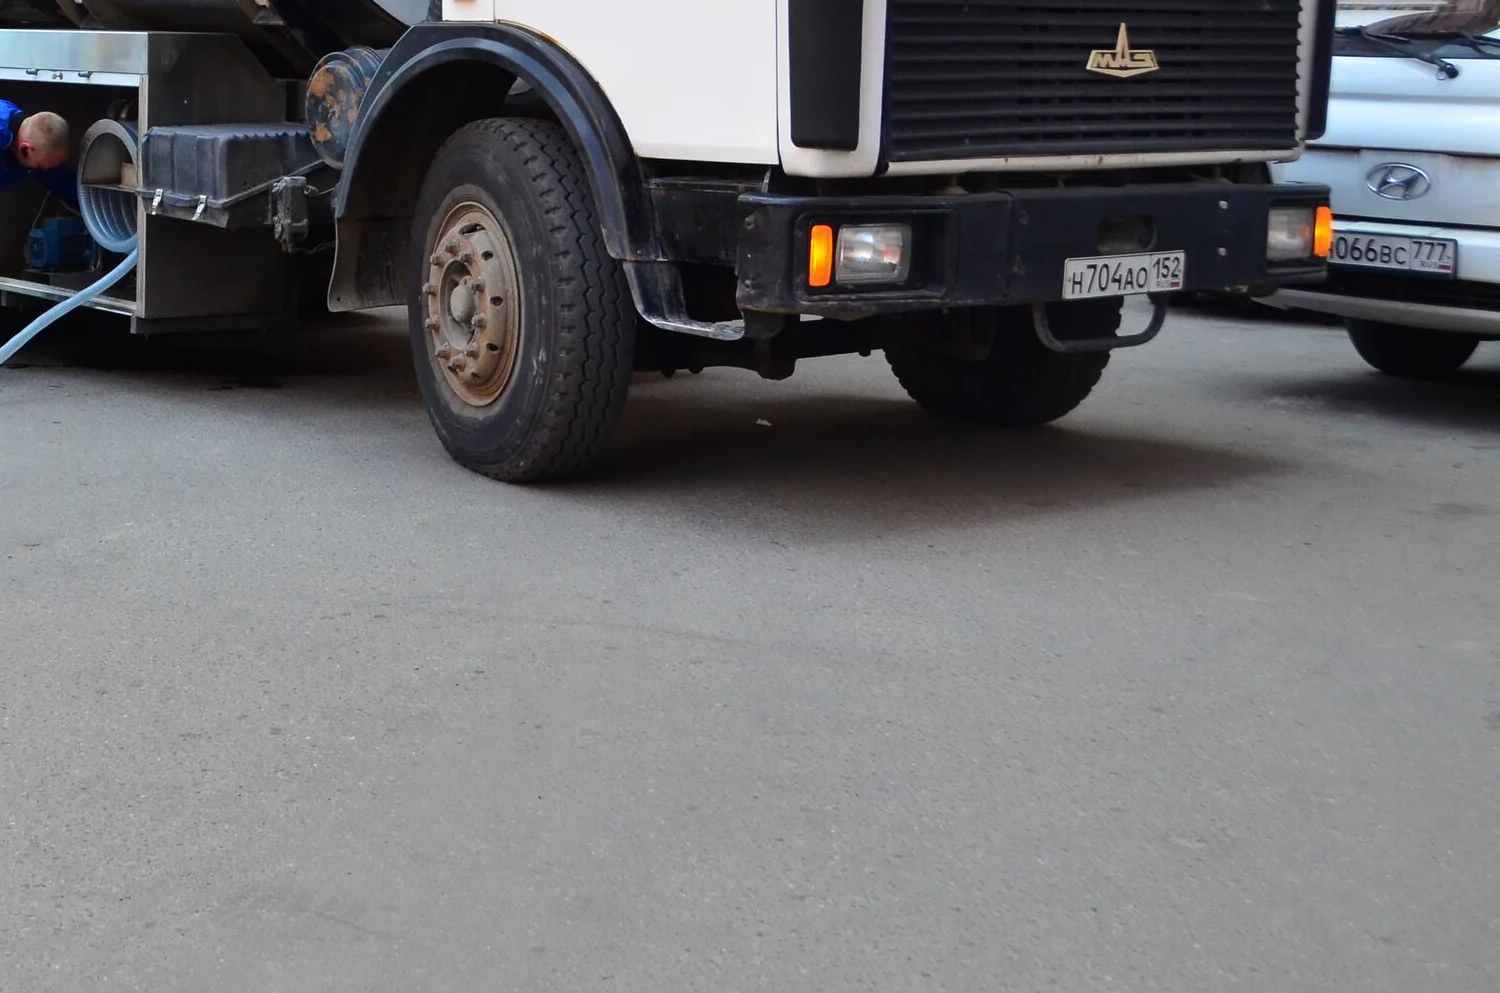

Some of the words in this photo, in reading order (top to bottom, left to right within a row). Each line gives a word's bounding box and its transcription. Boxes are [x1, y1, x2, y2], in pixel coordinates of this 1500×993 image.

[1329, 236, 1408, 265] 066ВС
[1412, 240, 1447, 262] 777
[1152, 256, 1181, 280] 152
[1420, 260, 1439, 270] RUS
